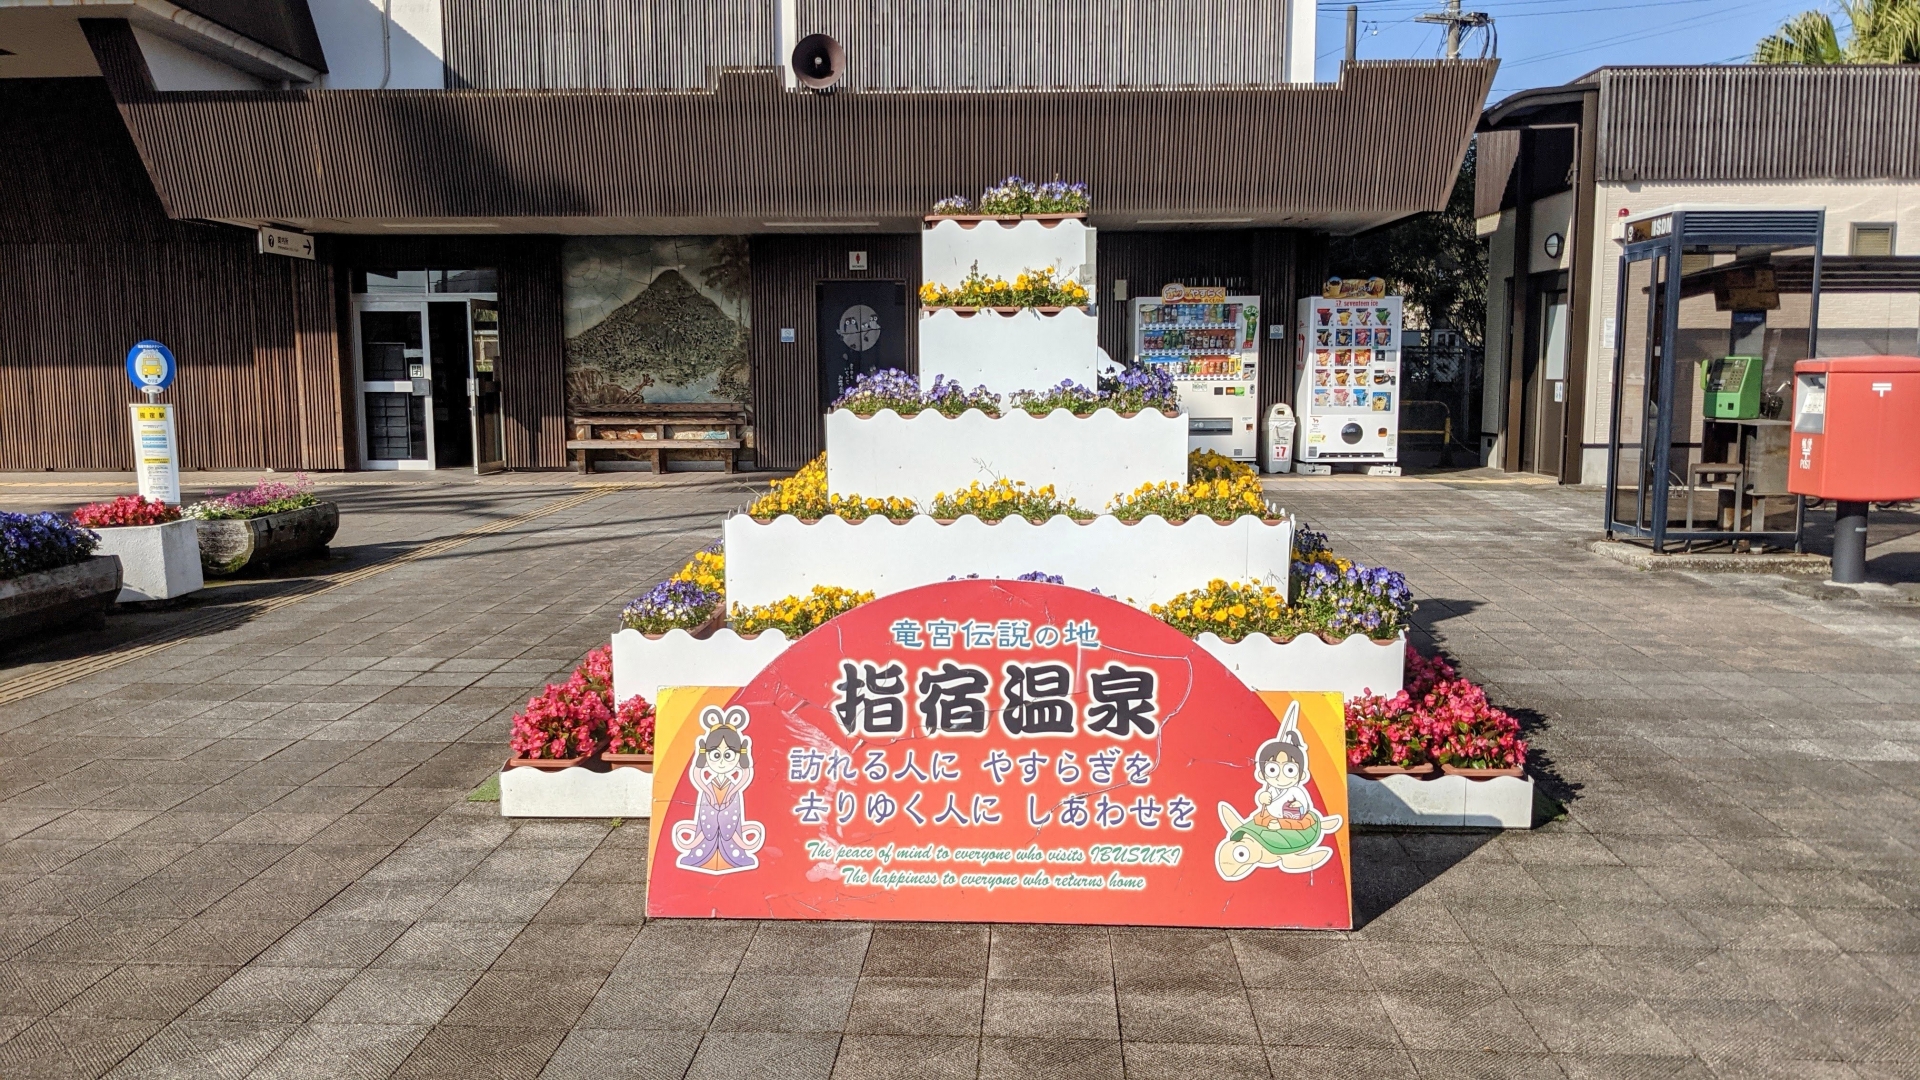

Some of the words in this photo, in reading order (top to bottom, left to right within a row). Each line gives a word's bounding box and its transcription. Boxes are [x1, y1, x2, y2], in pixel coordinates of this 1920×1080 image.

[1801, 438, 1813, 449] 郵便
[1799, 459, 1811, 470] POST
[890, 619, 1100, 649] 竜宮伝説の地
[836, 662, 1158, 736] 指宿温泉
[790, 749, 959, 782] 訪れる人に
[983, 749, 1151, 784] やすらぎを
[794, 793, 1001, 826] 去りゆく人に
[1027, 794, 1195, 830] しあわせを
[806, 841, 833, 859] The
[835, 845, 875, 864] peace
[878, 842, 895, 864] of
[897, 843, 933, 860] mind
[935, 846, 950, 860] to
[954, 849, 1012, 866] everyone
[1016, 844, 1043, 862] who
[1048, 848, 1086, 863] visits
[1089, 845, 1182, 865] IBUSUKI
[841, 867, 867, 884] The
[871, 868, 938, 889] happiness
[942, 871, 957, 885] to
[961, 873, 1018, 891] everyone
[1022, 871, 1051, 887] who
[1054, 873, 1104, 888] returns
[1107, 871, 1146, 890] home
